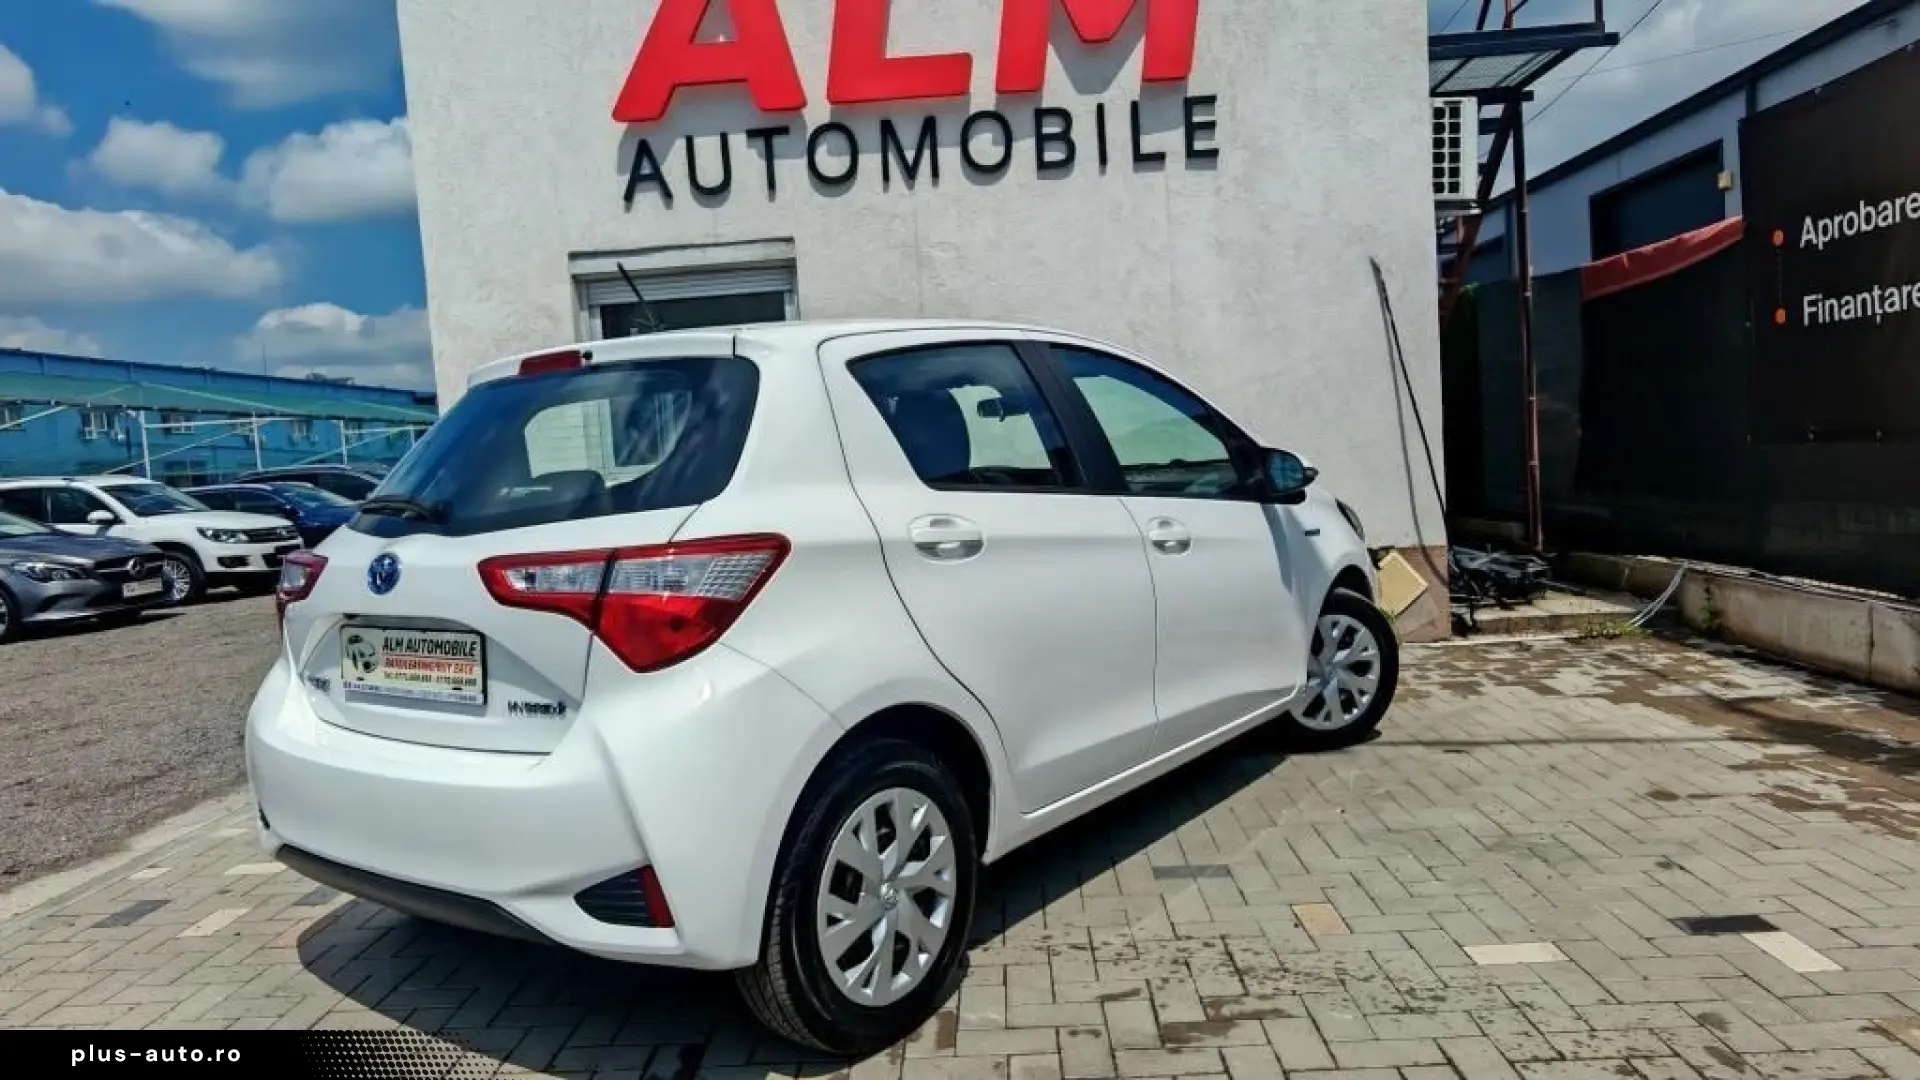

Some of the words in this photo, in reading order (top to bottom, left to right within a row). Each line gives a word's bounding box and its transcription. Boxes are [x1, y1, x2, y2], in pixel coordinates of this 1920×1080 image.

[612, 0, 1199, 122] ALM
[623, 94, 1220, 205] AUTOMOBILE
[1799, 192, 1920, 250] Aprobare
[1802, 281, 1920, 326] Finanțare
[382, 636, 404, 652] ALM
[405, 638, 477, 657] AUTOMOBILE
